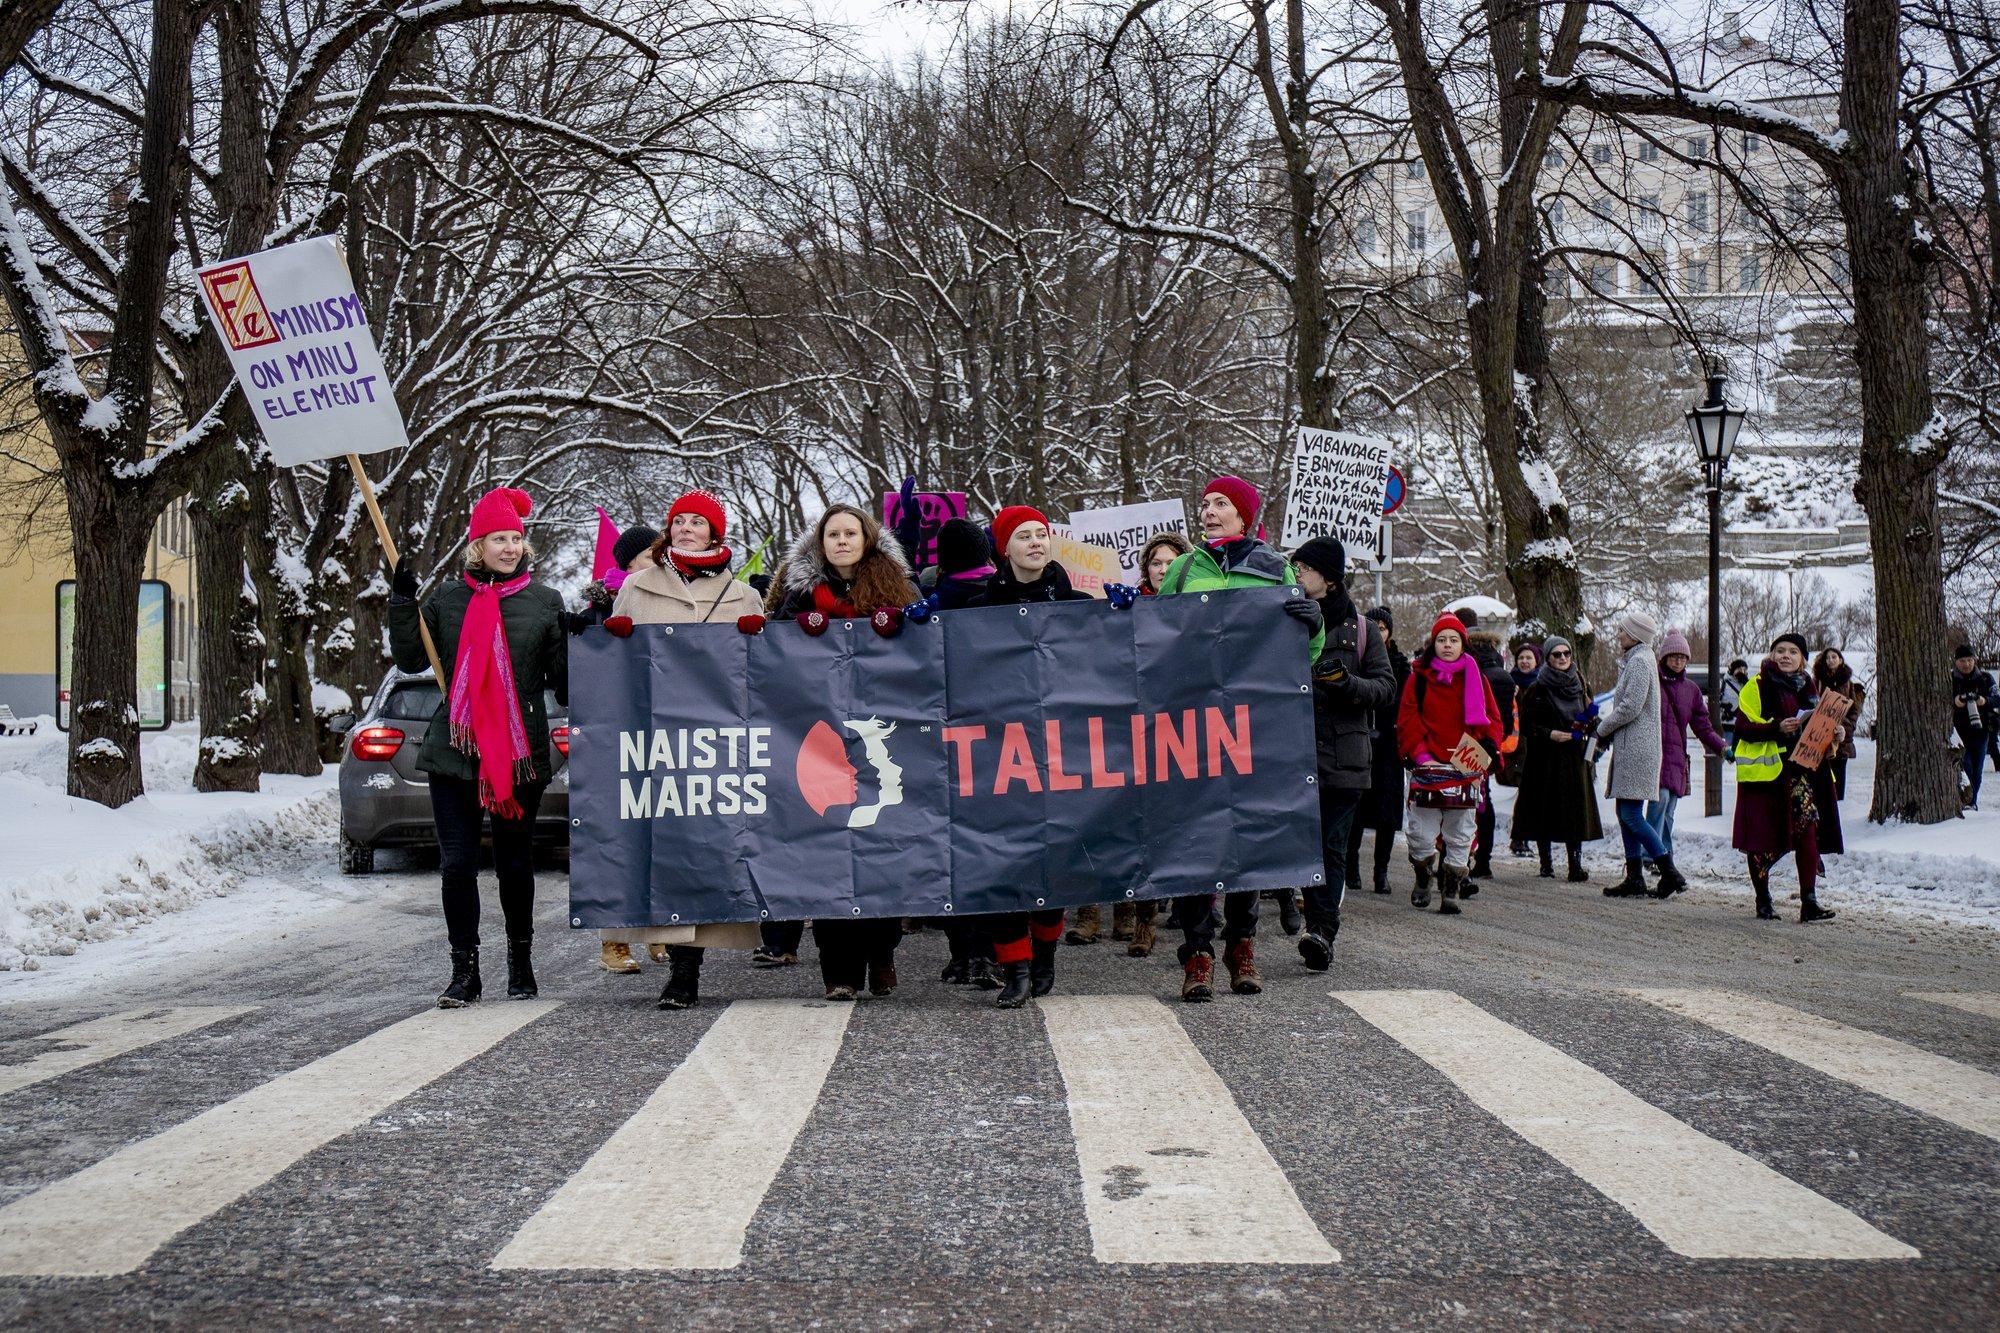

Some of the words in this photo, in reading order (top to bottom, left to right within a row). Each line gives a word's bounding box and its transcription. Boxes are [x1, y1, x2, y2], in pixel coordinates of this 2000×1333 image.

[250, 359, 284, 389] ON
[286, 341, 359, 382] MINU
[263, 376, 376, 420] ELEMENT
[1302, 433, 1388, 464] VABANDAGE
[1292, 488, 1313, 505] ME
[1315, 490, 1341, 506] SIIN
[1351, 480, 1384, 499] AGA
[1296, 504, 1373, 529] MAAILMA
[1297, 520, 1377, 551] PARANDADA
[1060, 543, 1105, 573] KING
[619, 727, 771, 772] NAISTE
[941, 704, 1253, 797] TALLINN
[619, 773, 767, 820] MARSS
